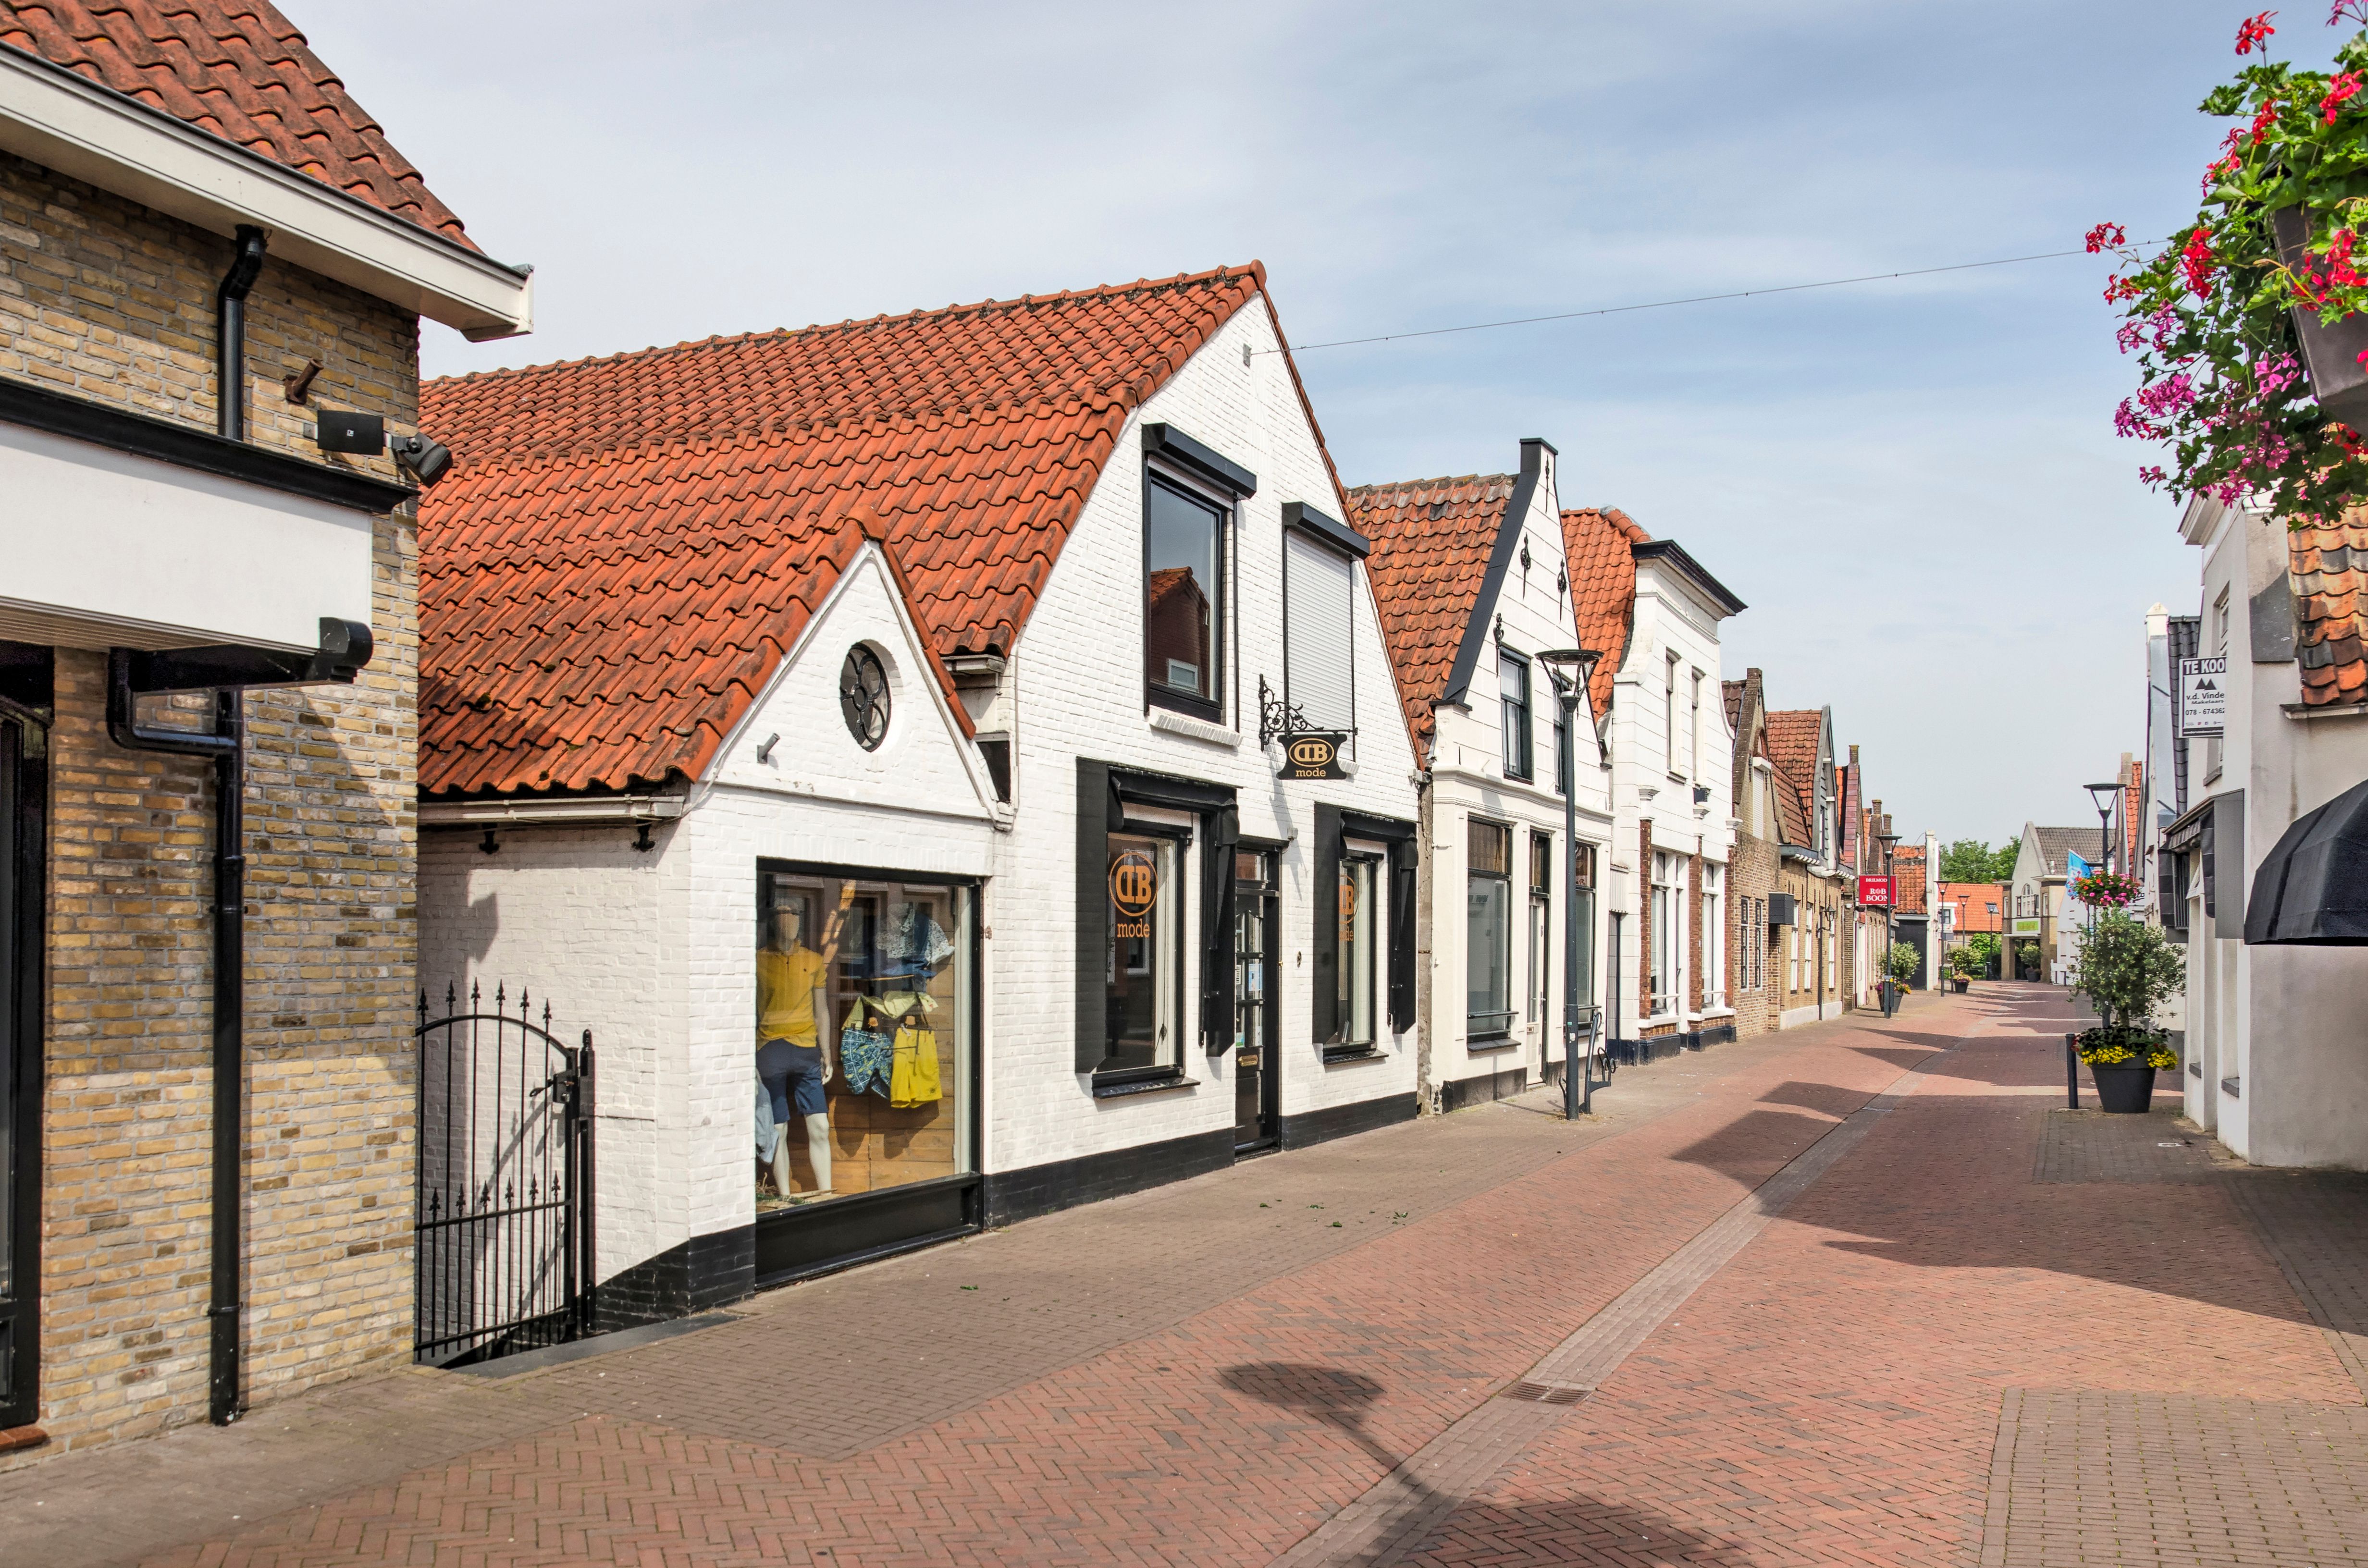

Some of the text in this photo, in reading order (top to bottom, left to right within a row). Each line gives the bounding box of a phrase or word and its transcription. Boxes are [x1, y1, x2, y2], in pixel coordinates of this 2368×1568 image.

[2184, 659, 2226, 674] TE KOO
[1295, 768, 1326, 777] mode
[1117, 918, 1150, 938] mode
